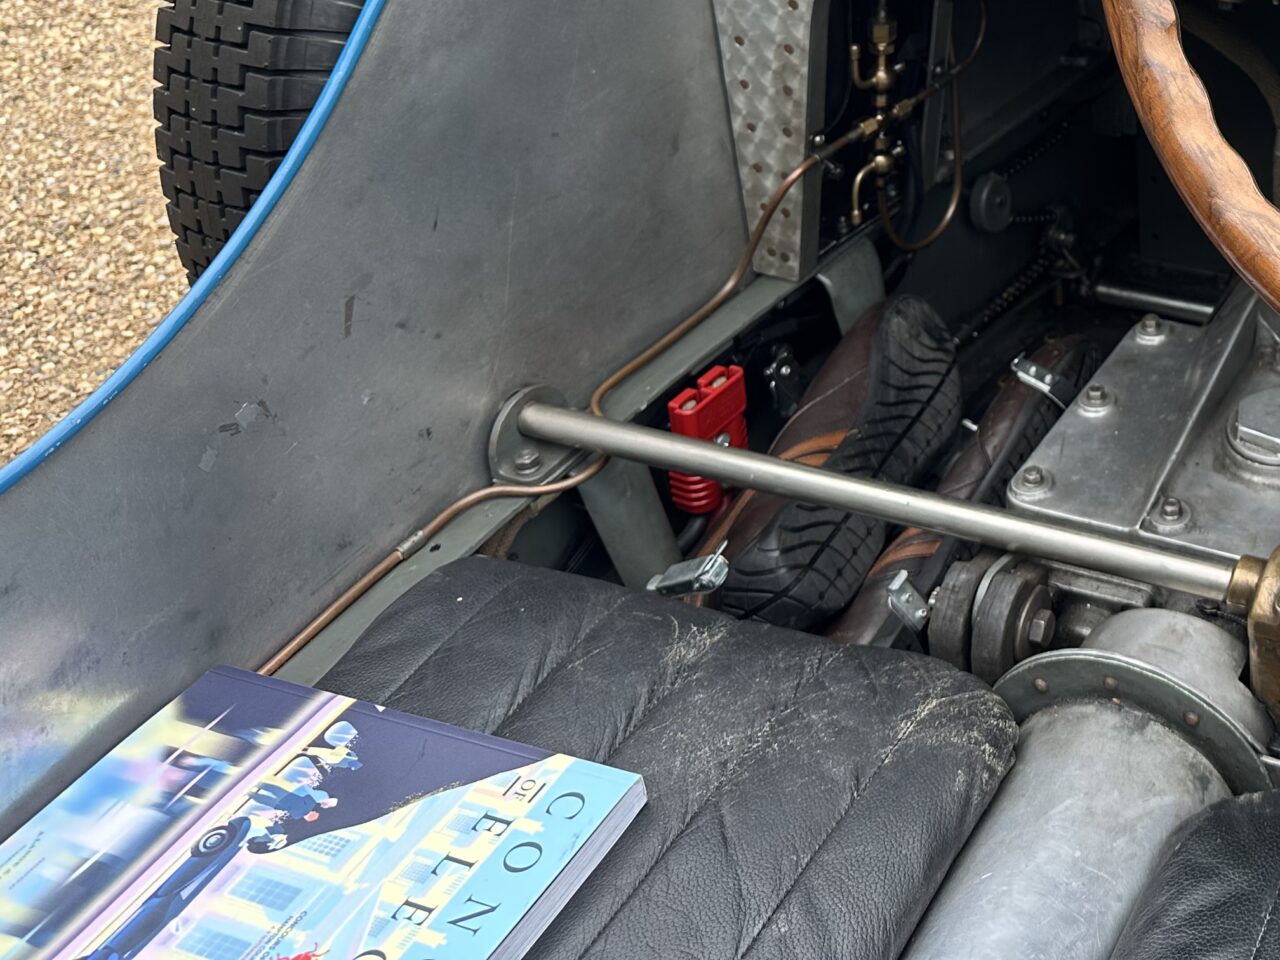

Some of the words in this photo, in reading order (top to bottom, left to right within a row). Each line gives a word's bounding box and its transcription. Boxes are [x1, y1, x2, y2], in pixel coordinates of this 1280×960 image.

[514, 778, 537, 802] OF
[353, 810, 516, 960] ELE
[424, 790, 586, 960] CON
